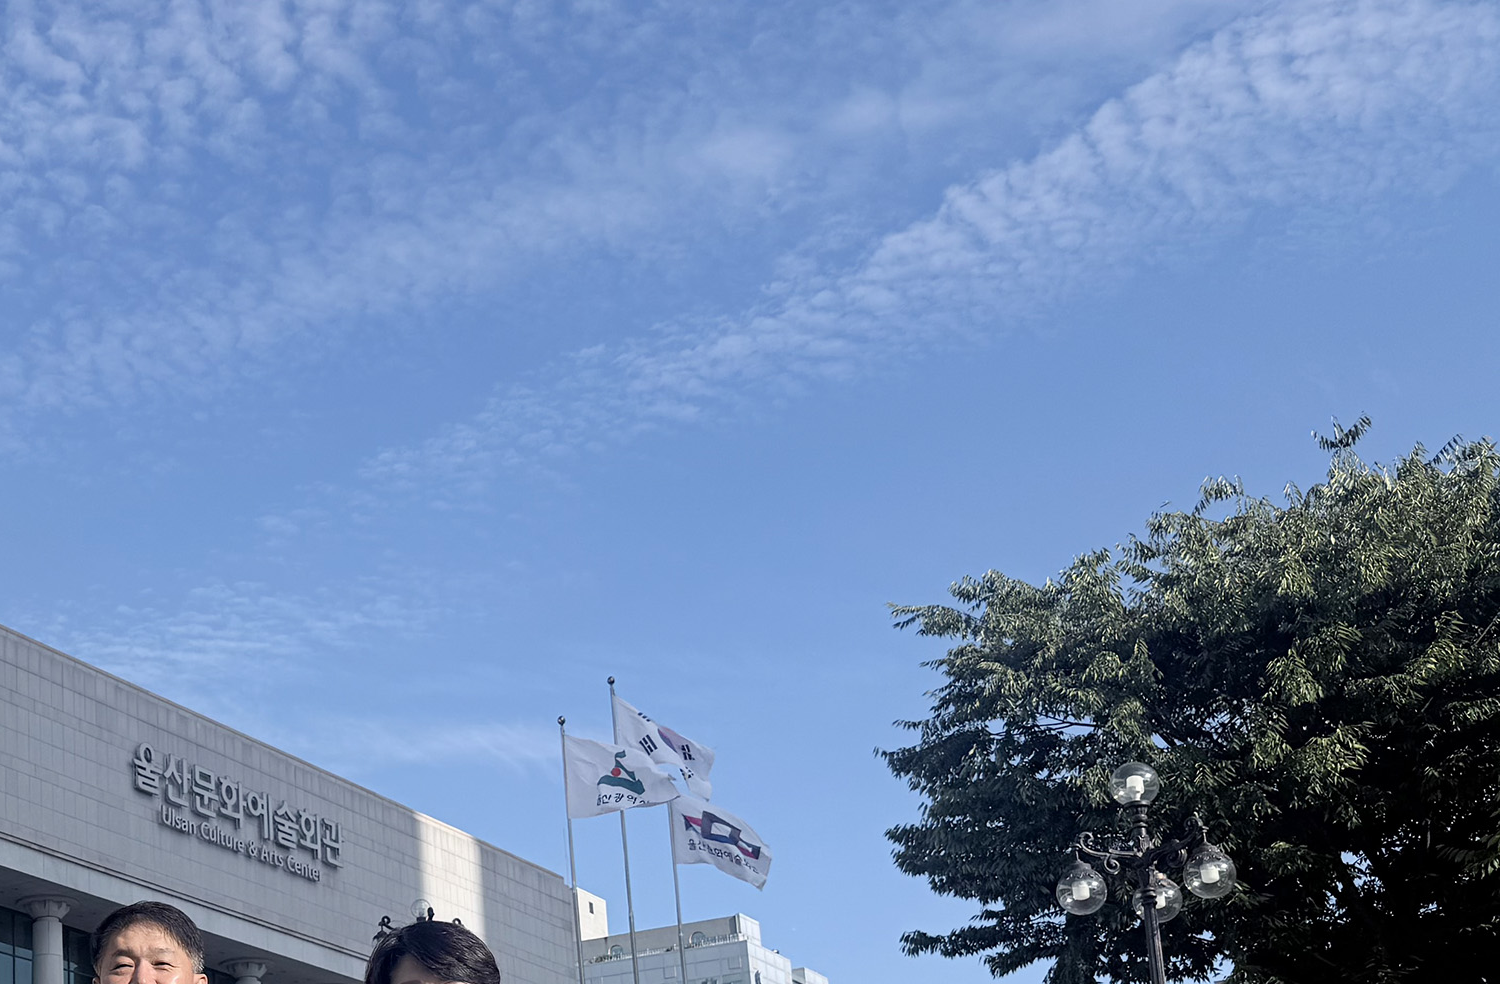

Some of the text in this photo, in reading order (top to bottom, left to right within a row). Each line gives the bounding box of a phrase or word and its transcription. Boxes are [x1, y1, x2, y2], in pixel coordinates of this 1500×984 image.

[133, 743, 344, 868] 울산문화예술회관
[161, 804, 321, 882] Ulsan Culture & Arts Center
